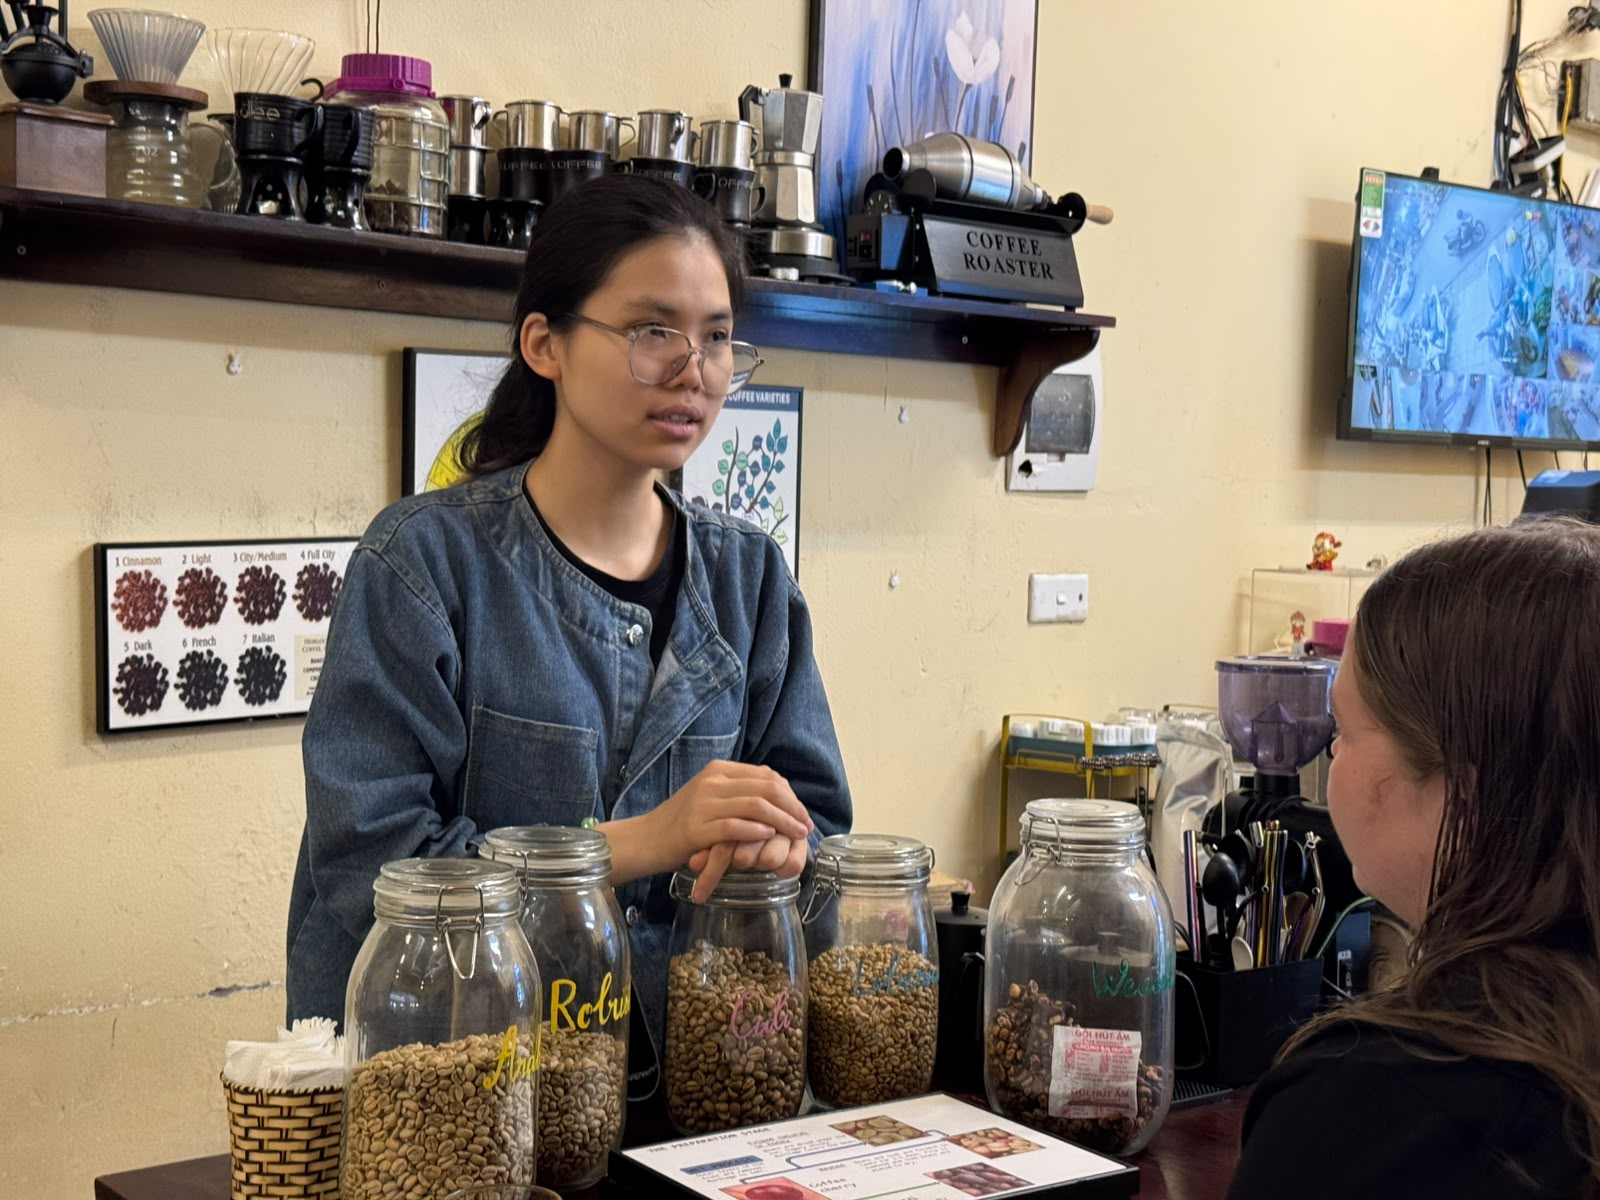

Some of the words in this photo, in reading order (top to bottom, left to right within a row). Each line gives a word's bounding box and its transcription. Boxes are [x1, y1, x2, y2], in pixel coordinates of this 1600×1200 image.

[966, 230, 1043, 257] COFFEE
[963, 252, 1054, 280] ROASTER
[756, 391, 790, 404] VARIETIES
[182, 554, 187, 564] 2
[191, 553, 211, 566] Light
[233, 553, 238, 562] 3
[240, 551, 287, 564] City/Medium
[300, 550, 305, 560] 4
[307, 549, 320, 560] Full
[322, 549, 335, 560] City
[116, 557, 120, 567] 1
[122, 556, 162, 567] Cinnamon
[182, 637, 187, 648] 6
[192, 636, 217, 648] French
[243, 634, 248, 645] 7
[252, 633, 275, 644] Italian
[124, 642, 129, 652] 5
[134, 640, 153, 651] Dark
